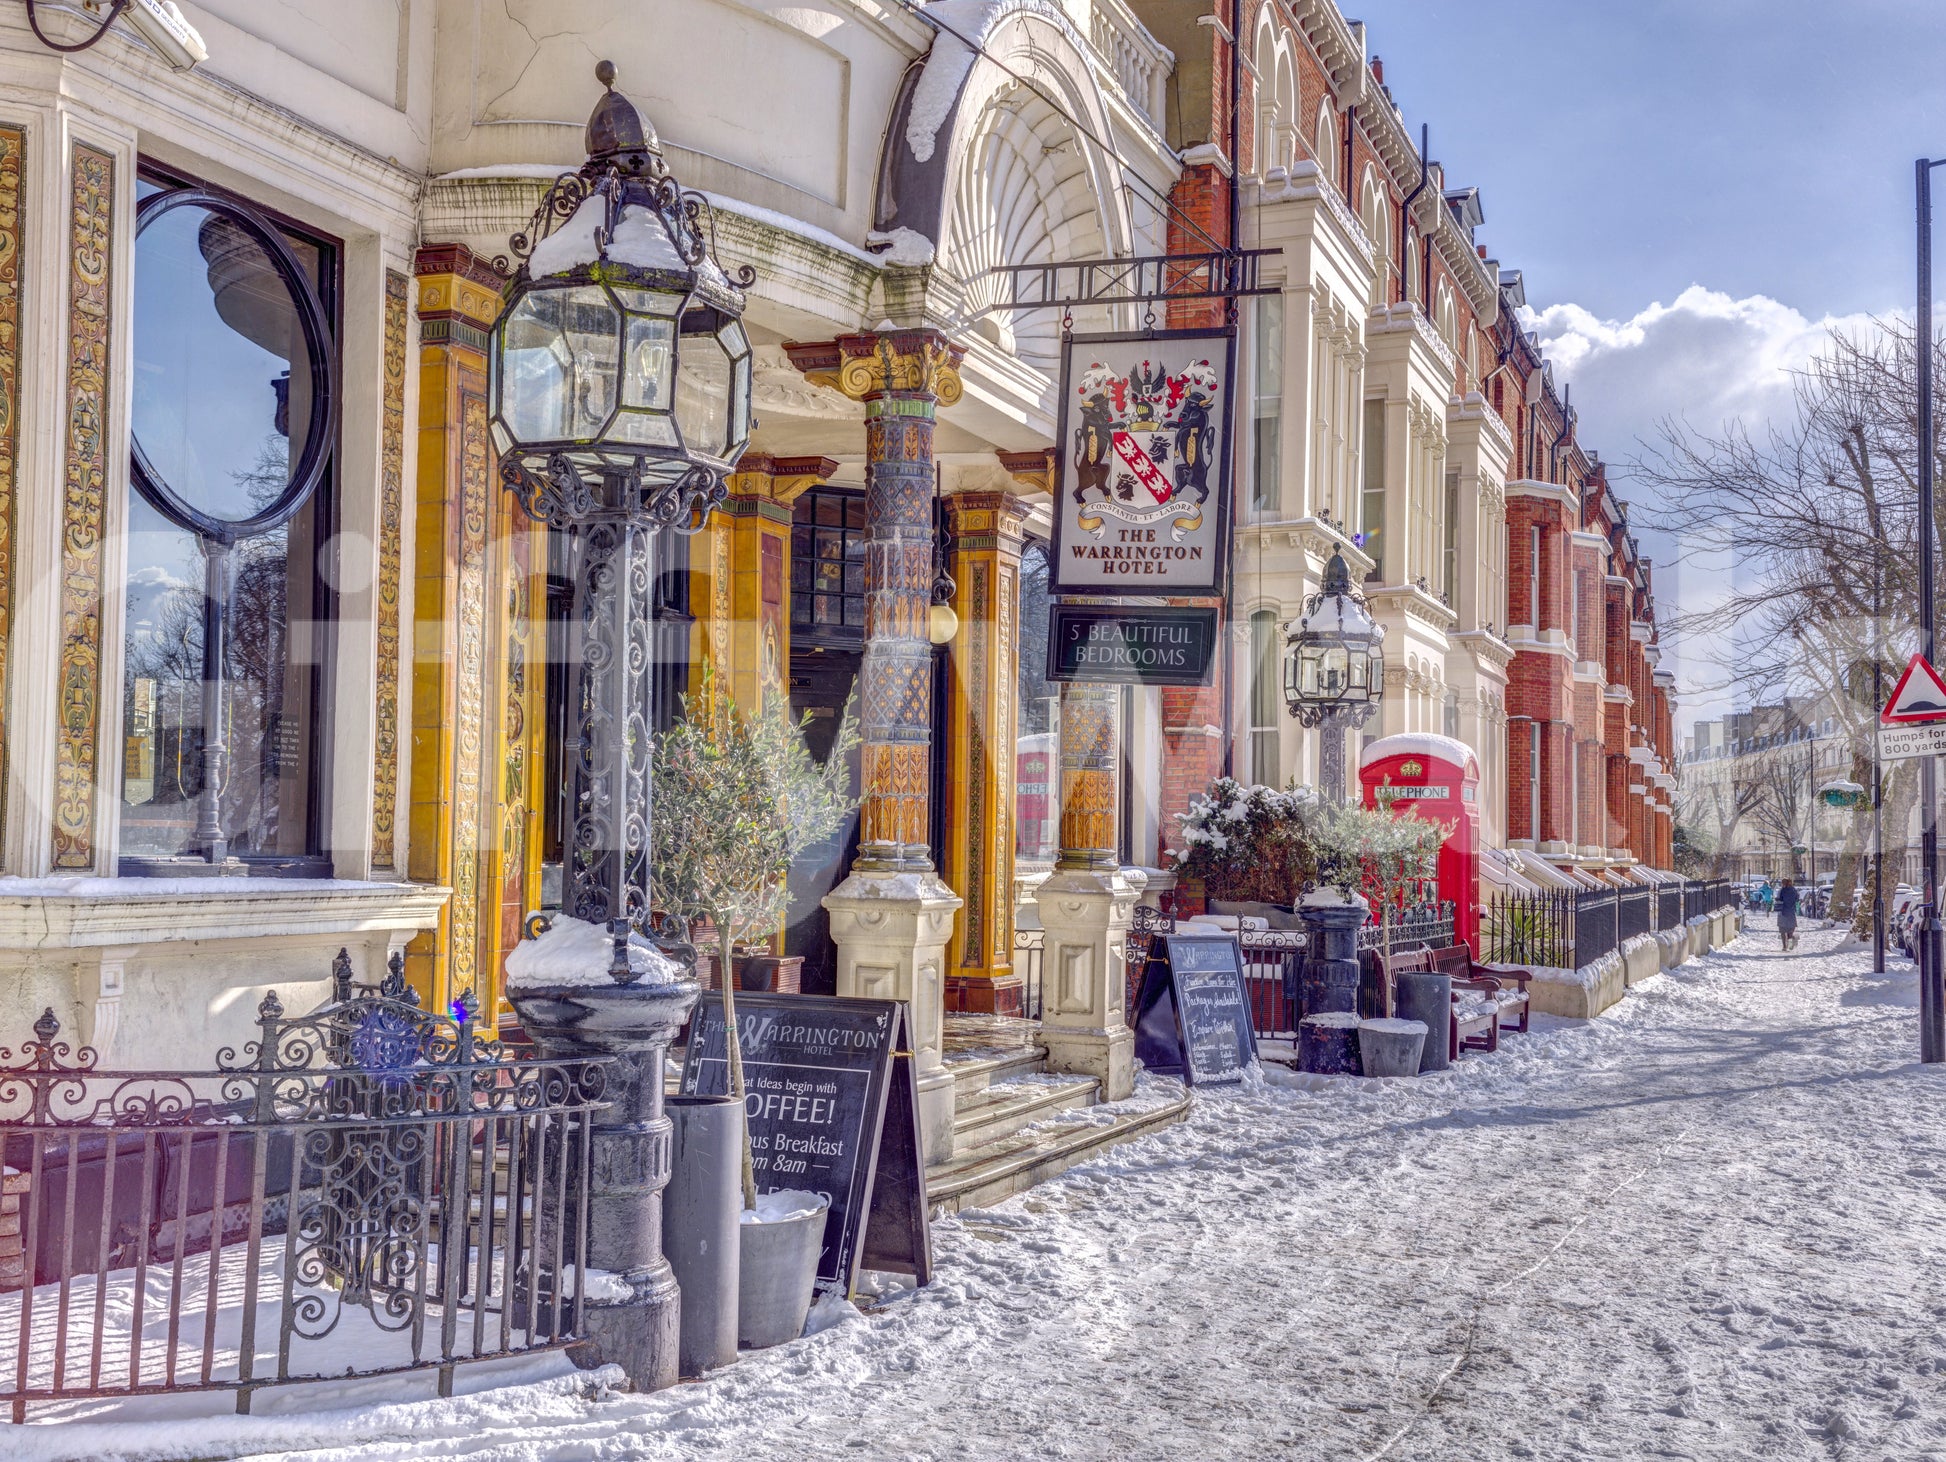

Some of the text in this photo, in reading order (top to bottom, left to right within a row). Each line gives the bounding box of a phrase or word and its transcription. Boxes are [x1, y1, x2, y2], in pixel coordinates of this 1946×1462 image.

[1091, 503, 1138, 521] CONSTANTIA
[1160, 503, 1192, 516] LABORE
[1118, 529, 1156, 542] THE
[1072, 545, 1202, 560] WARRINGTON
[1103, 561, 1167, 574] HOTEL
[1070, 624, 1193, 644] 5 BEAUTIFUL
[1075, 646, 1186, 666] BEDROOMS
[1883, 729, 1945, 743] Humps for
[1884, 740, 1946, 754] 800 yards
[739, 1014, 880, 1052] WARRINGTON
[803, 1045, 832, 1056] HOTEL
[757, 1077, 782, 1090] Ideas
[786, 1079, 812, 1095] begin
[816, 1082, 837, 1095] with
[744, 1092, 836, 1124] OFFEE!
[775, 1133, 844, 1156] Breakfast
[772, 1154, 807, 1173] 8am
